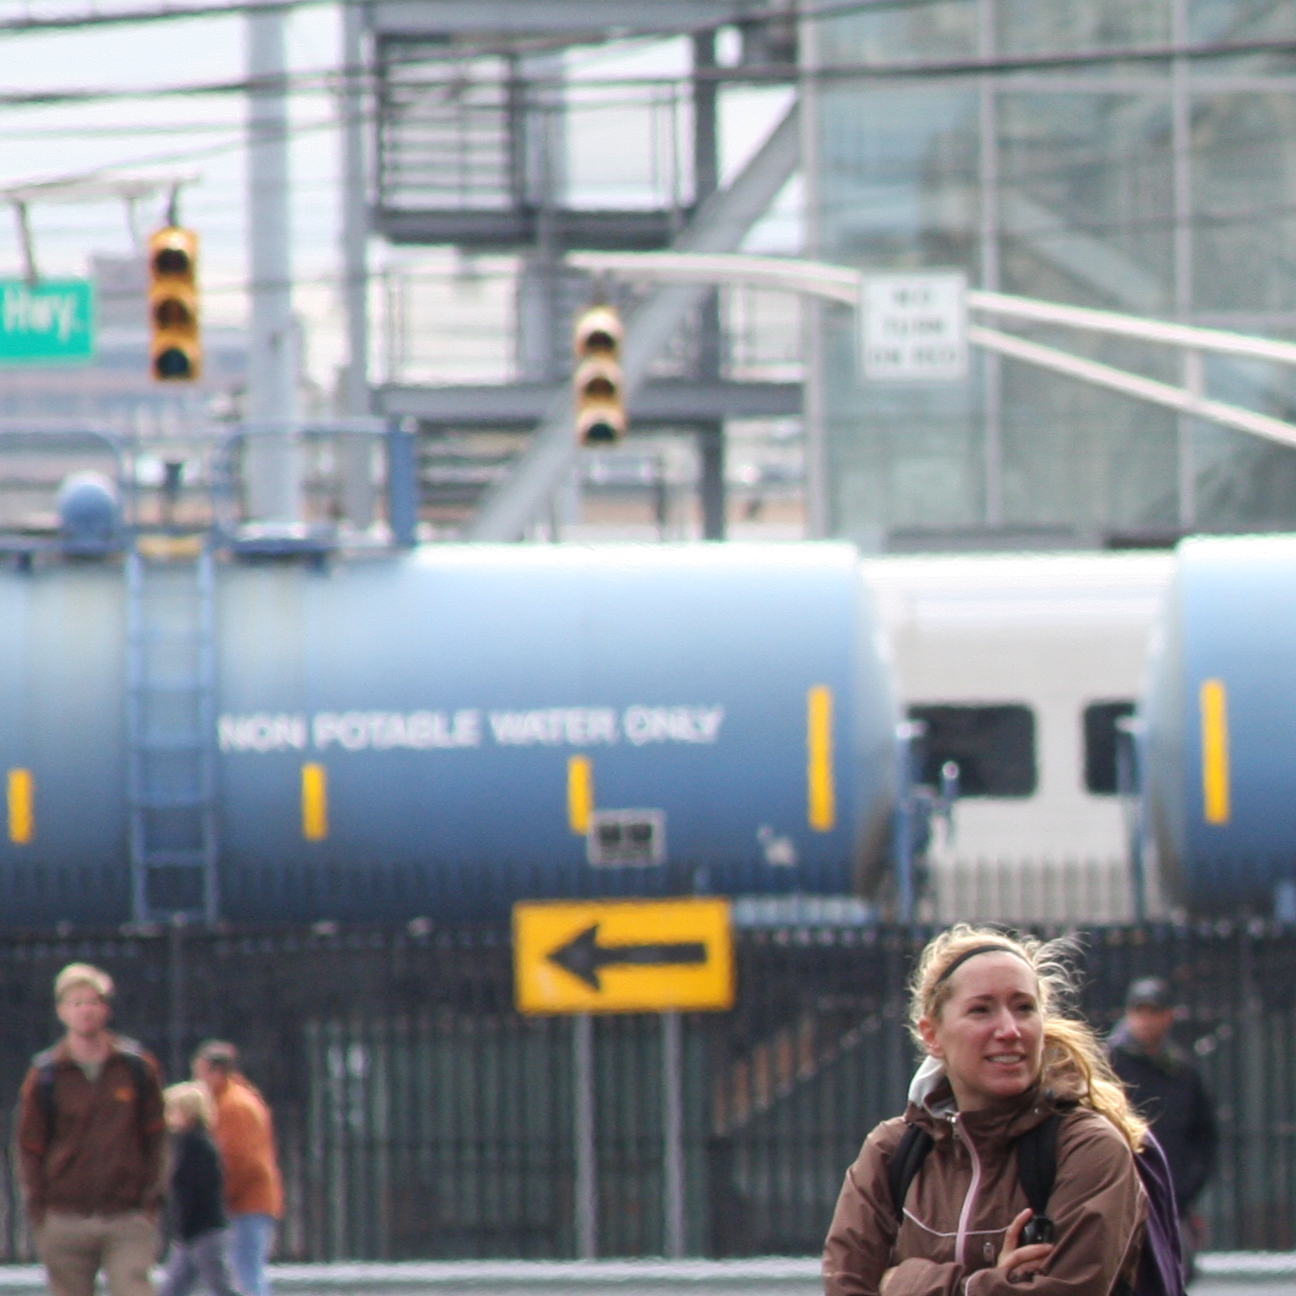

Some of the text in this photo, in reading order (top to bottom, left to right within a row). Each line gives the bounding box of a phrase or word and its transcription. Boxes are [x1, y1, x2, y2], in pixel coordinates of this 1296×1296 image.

[217, 704, 724, 752] NON POTABLE WATER ONLY
